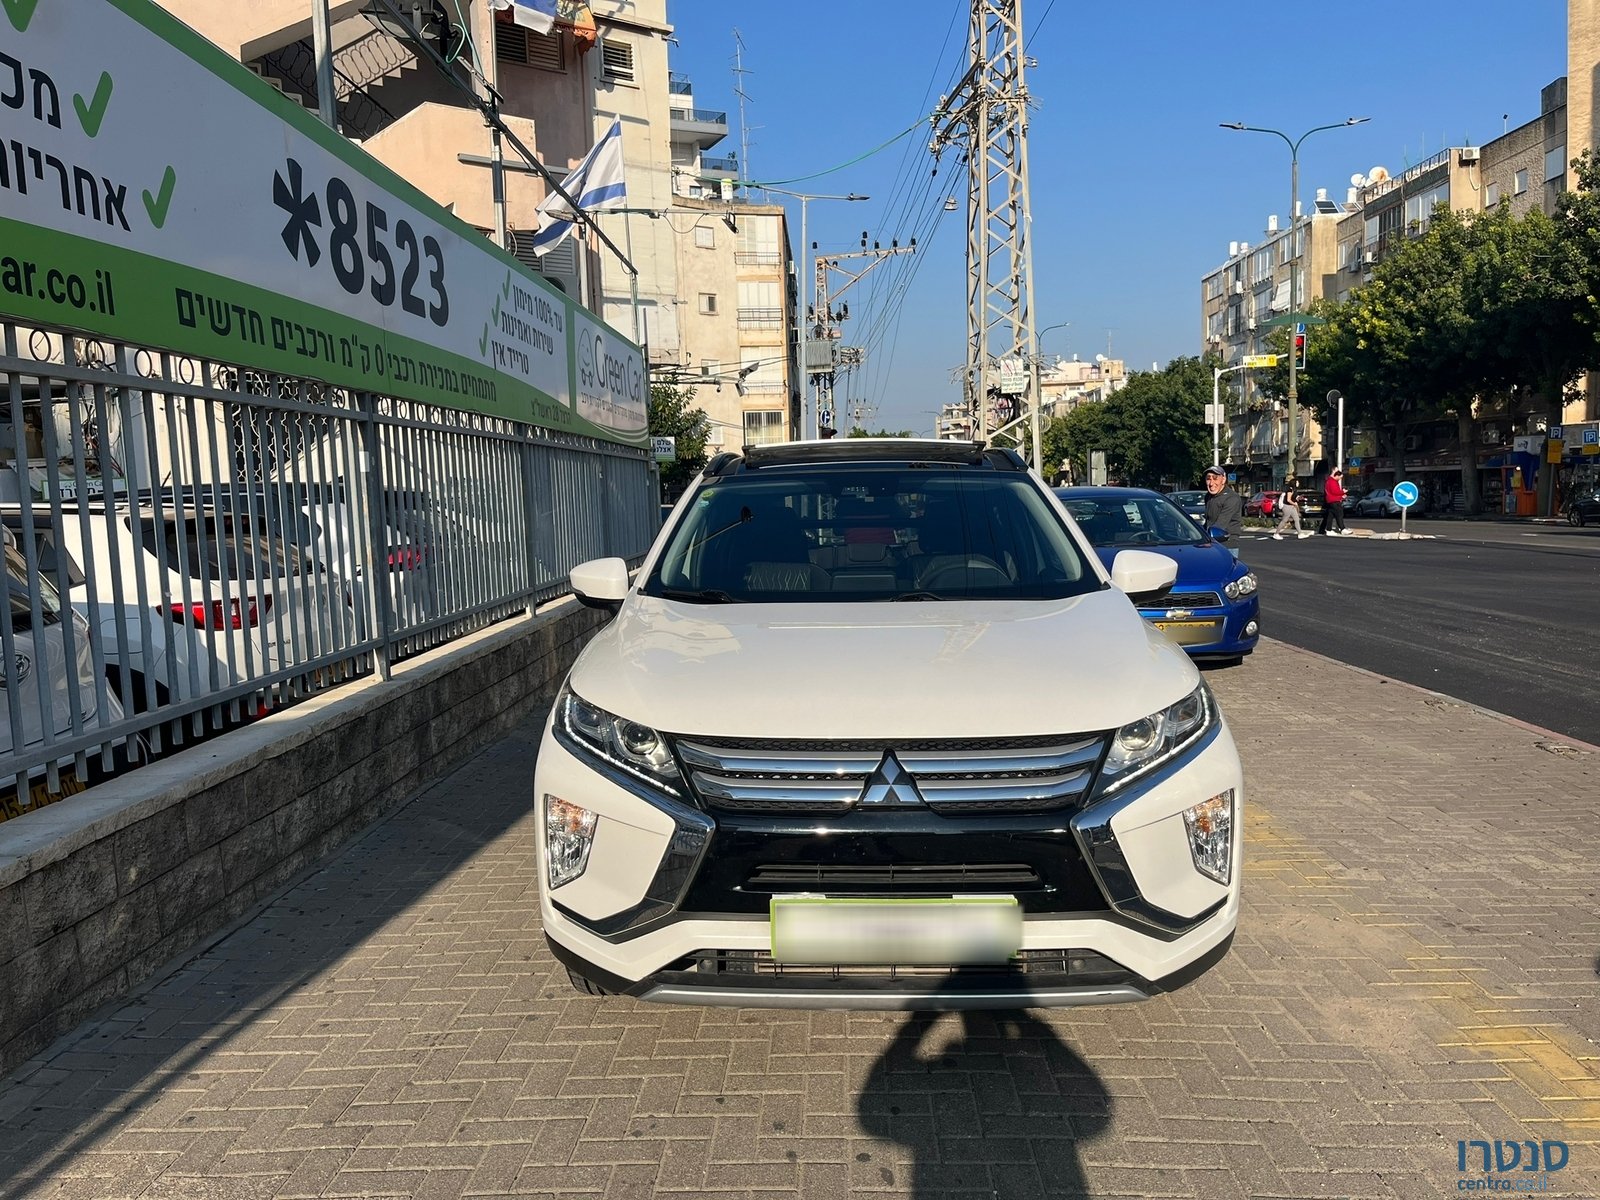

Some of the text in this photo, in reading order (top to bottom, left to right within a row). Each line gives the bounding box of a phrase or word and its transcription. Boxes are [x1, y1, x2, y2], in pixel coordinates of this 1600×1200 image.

[512, 284, 533, 313] מימון
[175, 287, 497, 402] מתמחים במכירת רכבי 0 ק"מ ורכבים חדשים
[491, 340, 506, 370] אין
[500, 310, 554, 355] שירות ואמינות
[595, 334, 642, 405] Green Car
